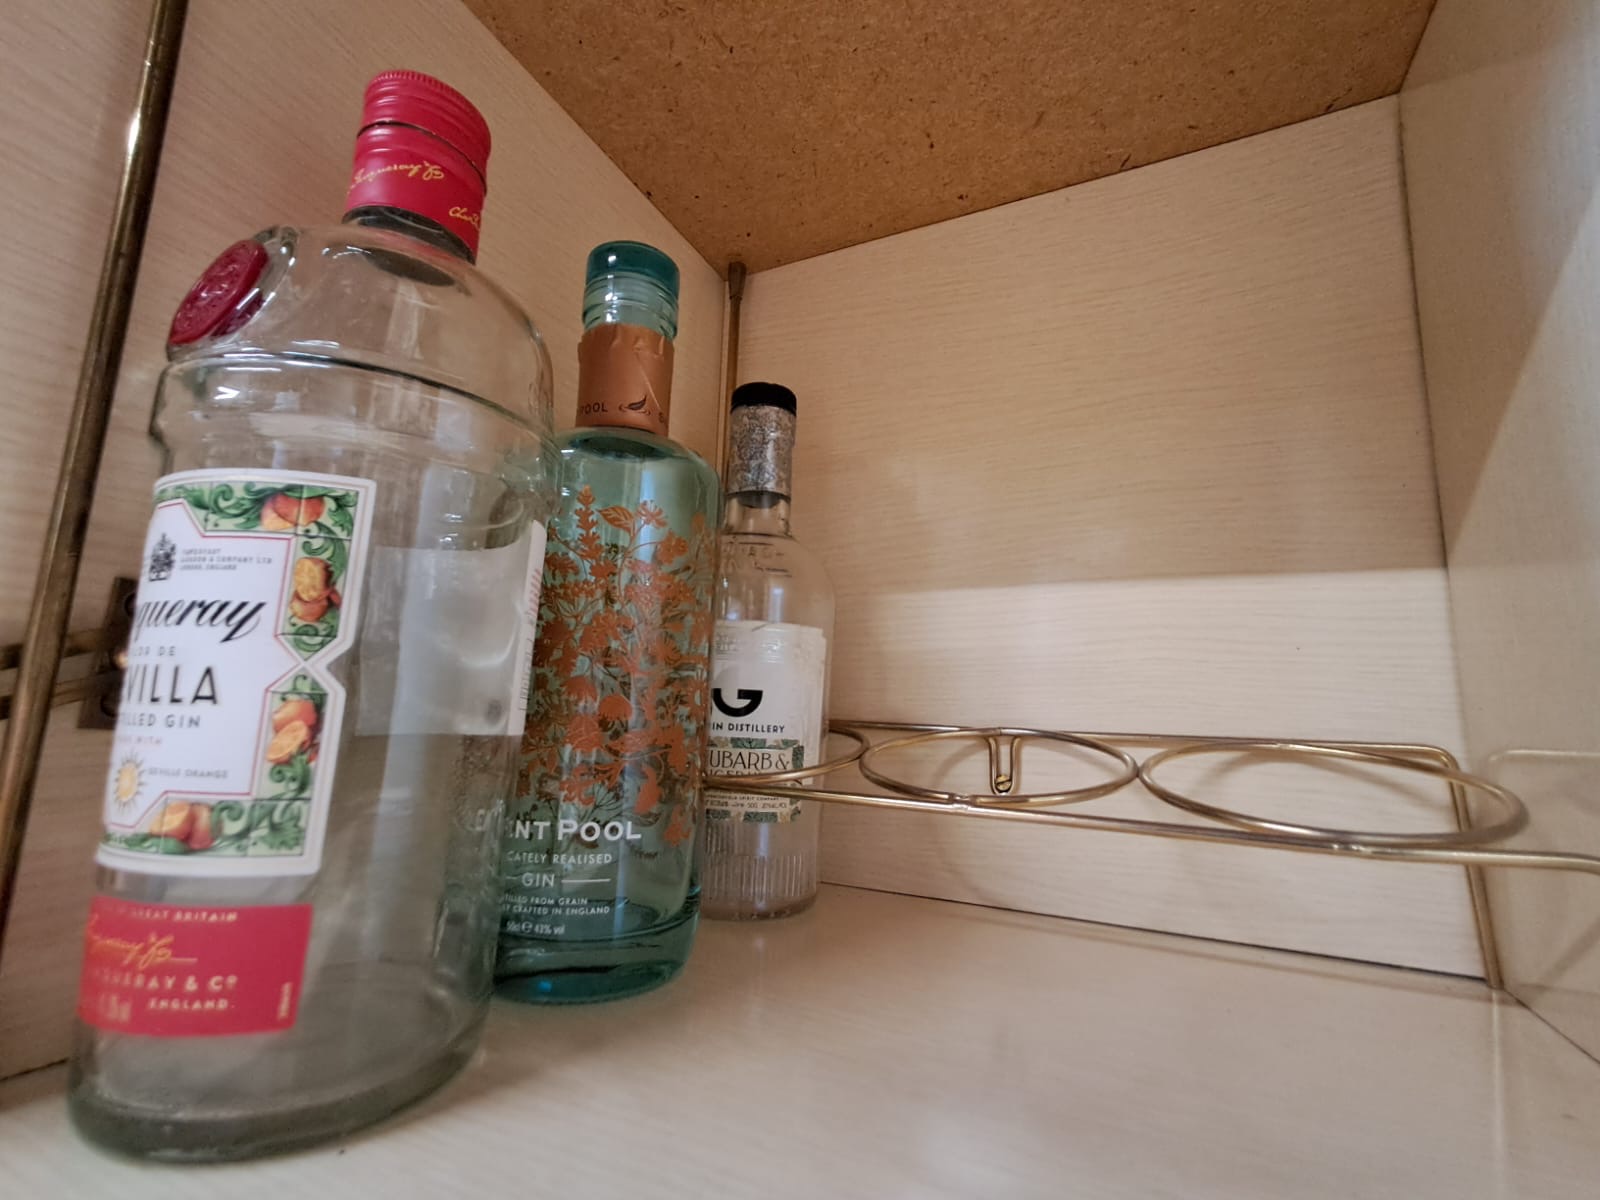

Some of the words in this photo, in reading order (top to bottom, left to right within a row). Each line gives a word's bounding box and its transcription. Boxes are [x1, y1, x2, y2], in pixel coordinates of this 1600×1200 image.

[712, 687, 764, 718] G
[165, 713, 201, 728] GIN
[727, 722, 786, 734] DISTILLERY
[709, 750, 773, 771] UBARB
[775, 753, 790, 770] &
[557, 820, 642, 842] POOL
[552, 852, 613, 865] REALISED
[521, 872, 555, 888] GIN
[530, 896, 555, 906] FROM
[558, 896, 588, 906] GRAIN
[173, 909, 239, 922] BRITAIN
[551, 906, 562, 916] IN
[565, 905, 611, 916] ENGLAND
[184, 974, 198, 992] &
